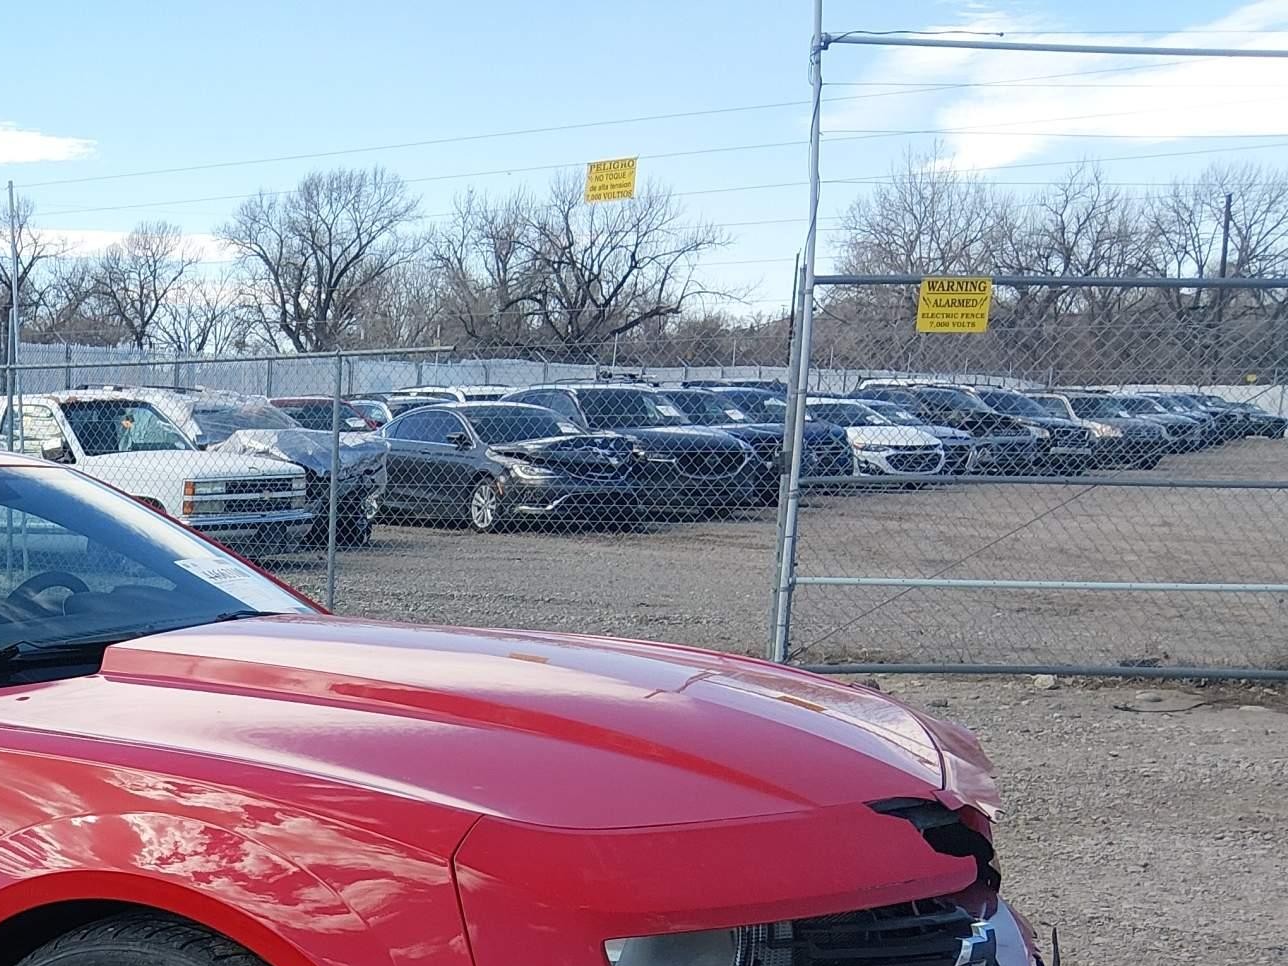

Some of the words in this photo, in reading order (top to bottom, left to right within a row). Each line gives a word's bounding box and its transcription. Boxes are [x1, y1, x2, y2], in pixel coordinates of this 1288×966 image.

[590, 159, 634, 173] PELIGRO
[606, 172, 626, 180] TOQUE
[603, 190, 632, 199] VOLTIOS
[927, 280, 987, 292] WARNING
[932, 298, 978, 308] ALARMED
